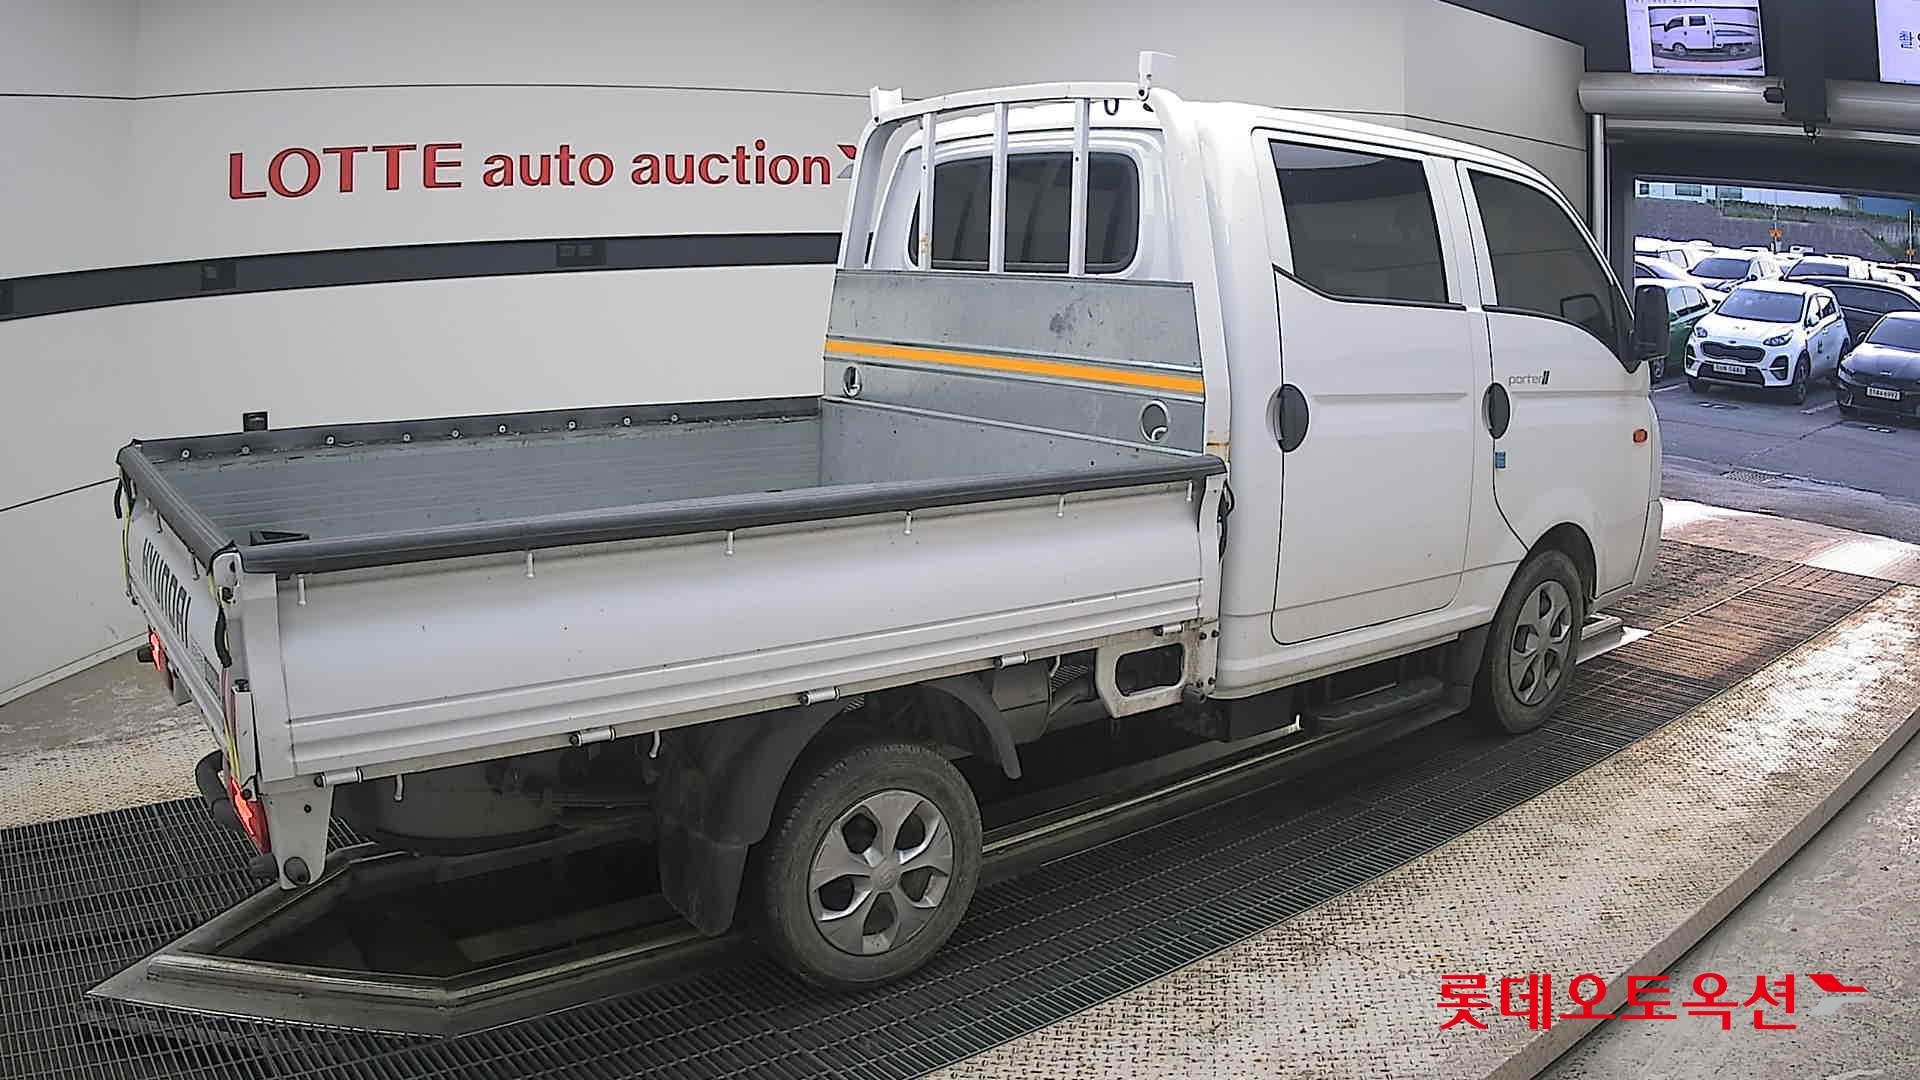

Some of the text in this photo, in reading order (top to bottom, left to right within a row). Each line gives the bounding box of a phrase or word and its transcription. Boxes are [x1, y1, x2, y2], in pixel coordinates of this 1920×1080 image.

[229, 140, 831, 200] LOTTE auto auction
[142, 537, 192, 649] HYUNDAI
